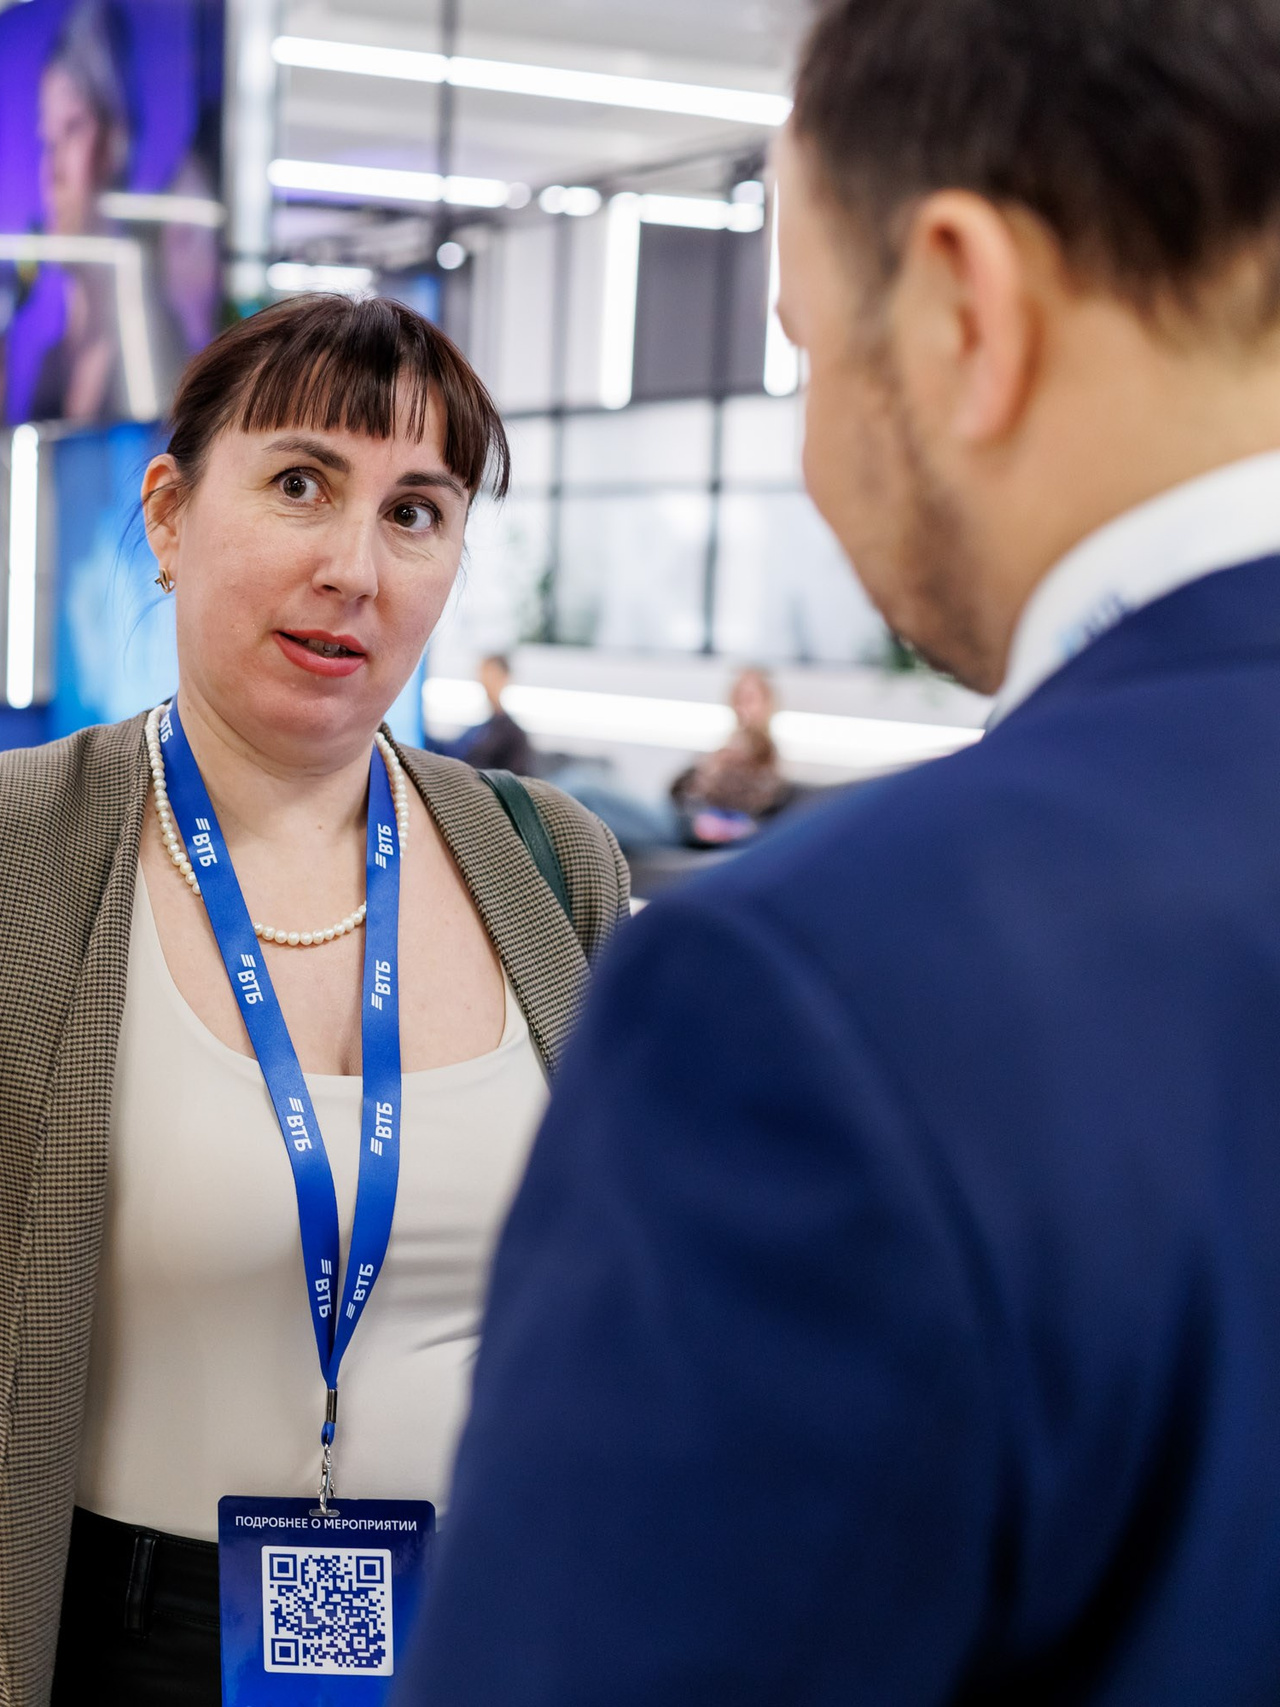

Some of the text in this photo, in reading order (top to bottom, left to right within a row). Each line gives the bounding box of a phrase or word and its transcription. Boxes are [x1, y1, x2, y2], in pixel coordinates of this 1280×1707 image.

[192, 832, 218, 867] ВТБ
[377, 823, 394, 856] ВТБ
[237, 969, 264, 1005] ВТБ
[375, 960, 391, 996] ВТБ
[286, 1114, 312, 1152] ВТБ
[375, 1102, 393, 1139] ВТБ
[315, 1278, 332, 1318] ВТБ
[353, 1263, 374, 1301] ВТБ
[235, 1515, 417, 1531] ПОДРОБНЕЕ О МЕРОПРИЯТИИ
